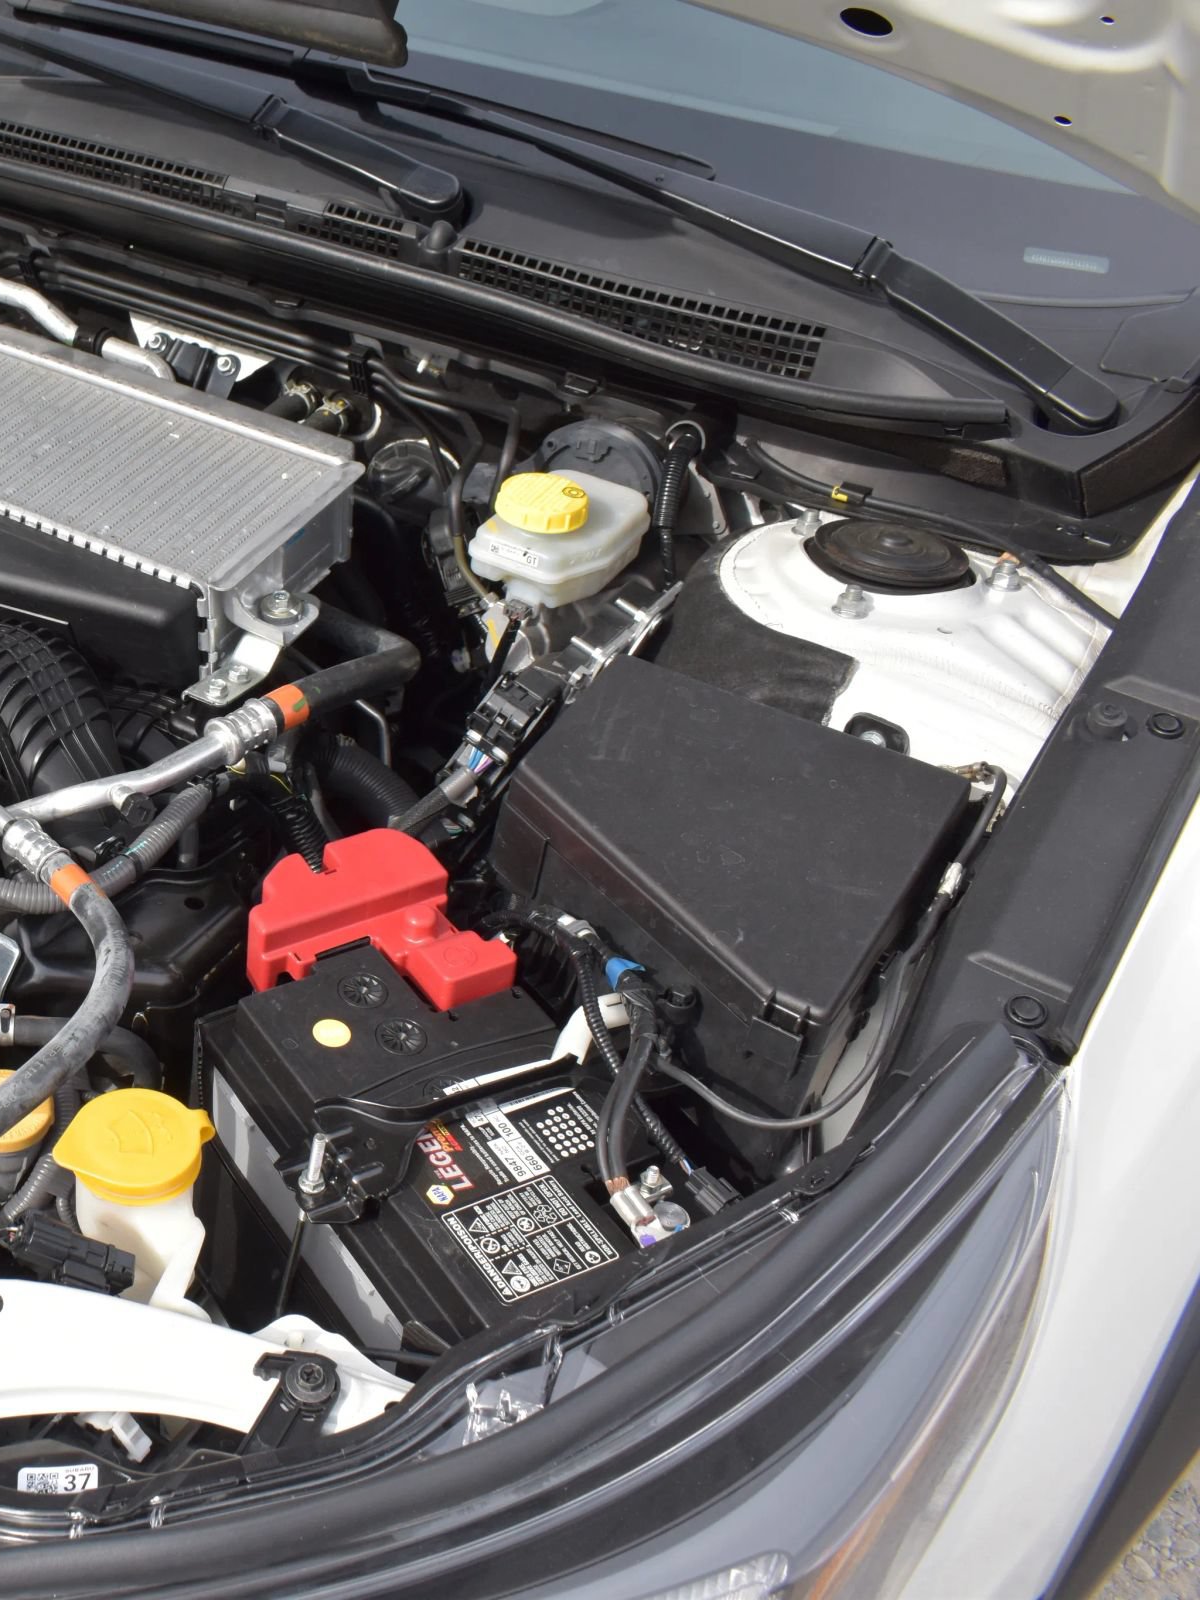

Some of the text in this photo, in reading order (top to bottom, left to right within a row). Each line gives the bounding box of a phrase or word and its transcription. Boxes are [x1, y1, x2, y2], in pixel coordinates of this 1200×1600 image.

[526, 555, 537, 566] GT
[495, 1121, 516, 1137] 100
[471, 1139, 490, 1157] batteries
[485, 1155, 498, 1167] used
[502, 1154, 528, 1177] 9847
[523, 1154, 544, 1171] 660
[486, 1168, 504, 1186] Recycle
[430, 1186, 449, 1202] NAPA
[535, 1181, 554, 1198] OPEN.
[545, 1178, 566, 1197] Battery
[548, 1196, 562, 1208] NOT
[559, 1195, 574, 1207] Acid
[567, 1205, 583, 1218] Lead
[445, 1215, 507, 1289] DANGER/POISON
[560, 1246, 577, 1263] MEDICAL
[63, 1473, 92, 1492] 37
